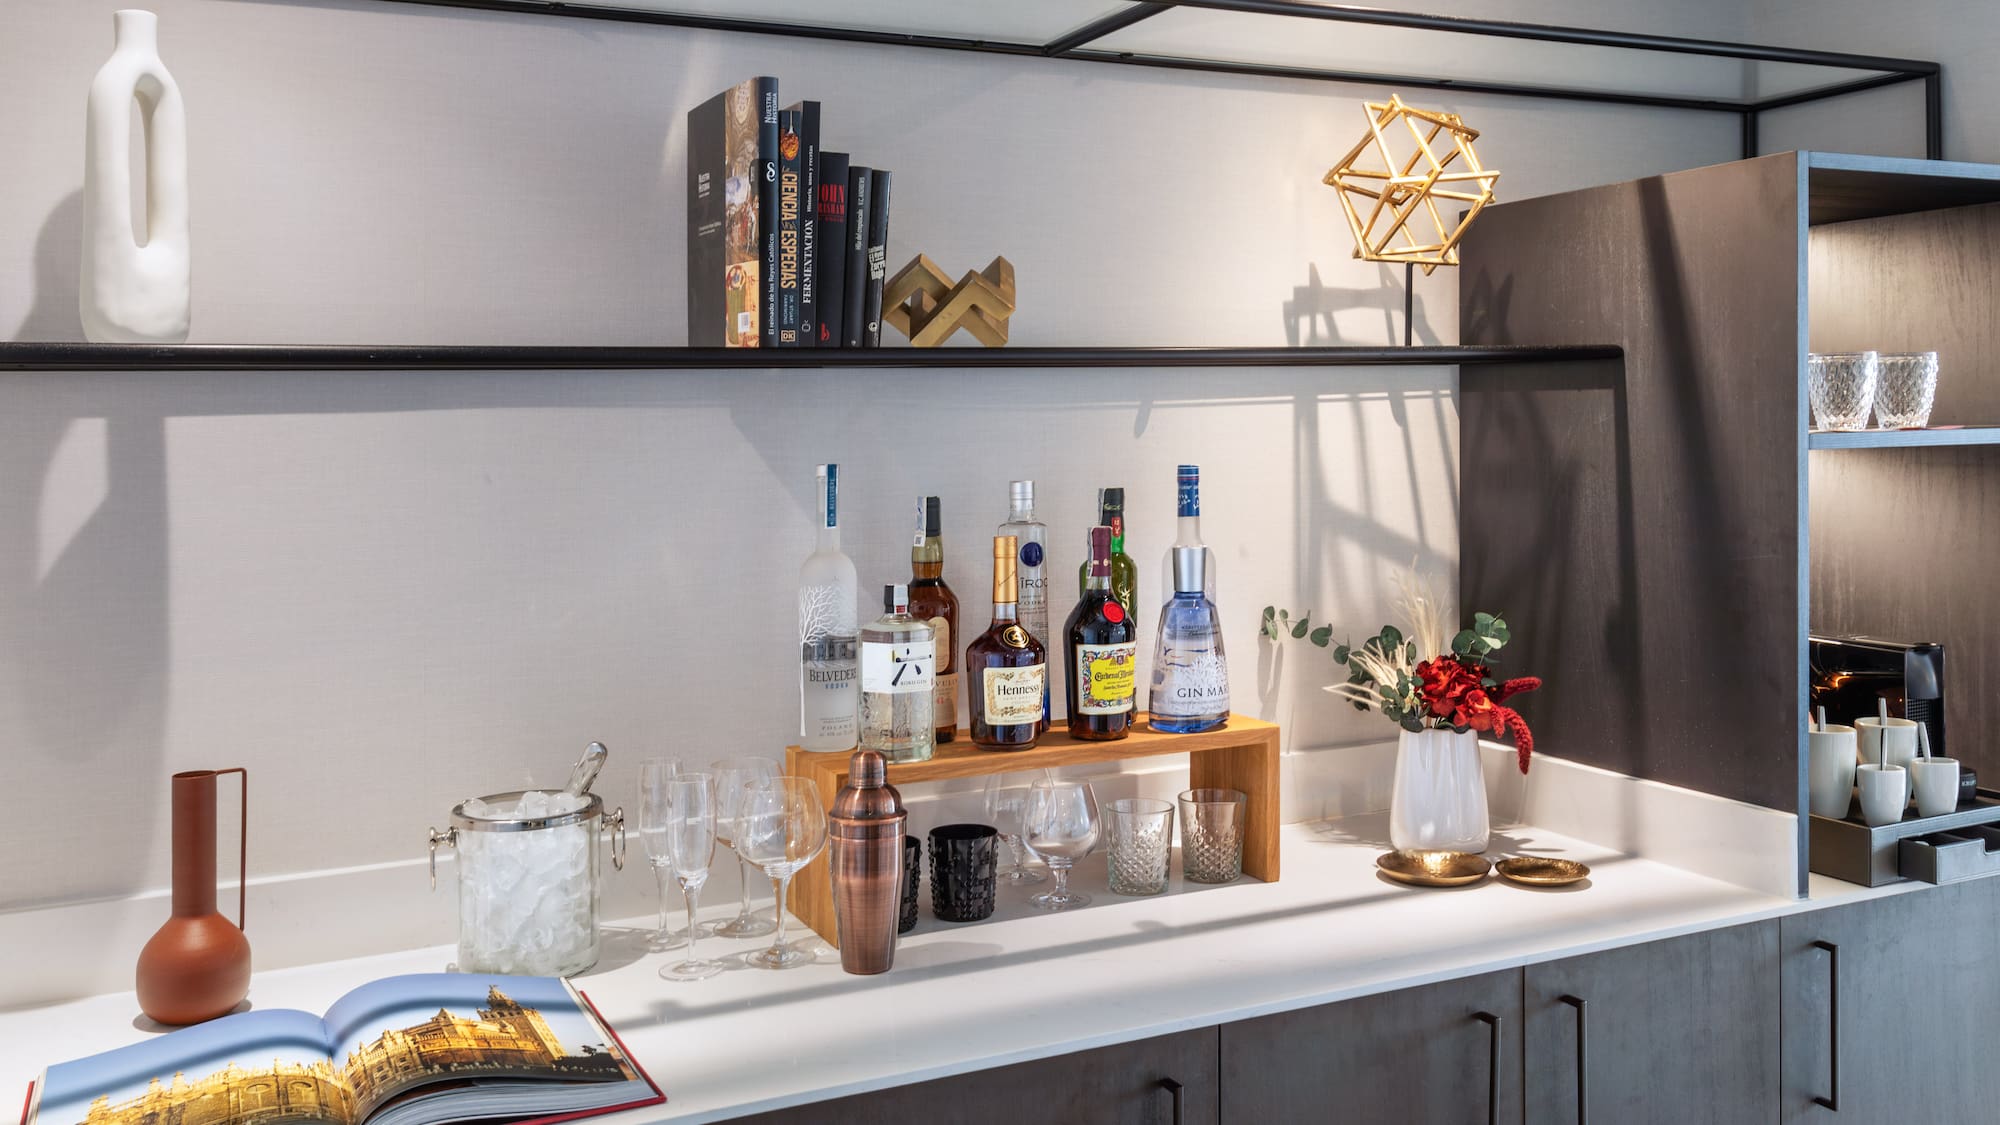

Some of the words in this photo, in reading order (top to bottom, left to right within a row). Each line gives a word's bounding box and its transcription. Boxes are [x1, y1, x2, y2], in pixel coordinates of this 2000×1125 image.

[781, 173, 798, 221] CIENCIA
[780, 230, 797, 288] ESPECIAS
[768, 263, 776, 282] Reyes
[768, 294, 775, 303] de
[997, 684, 1040, 696] Hennessy
[1177, 687, 1203, 698] GIN
